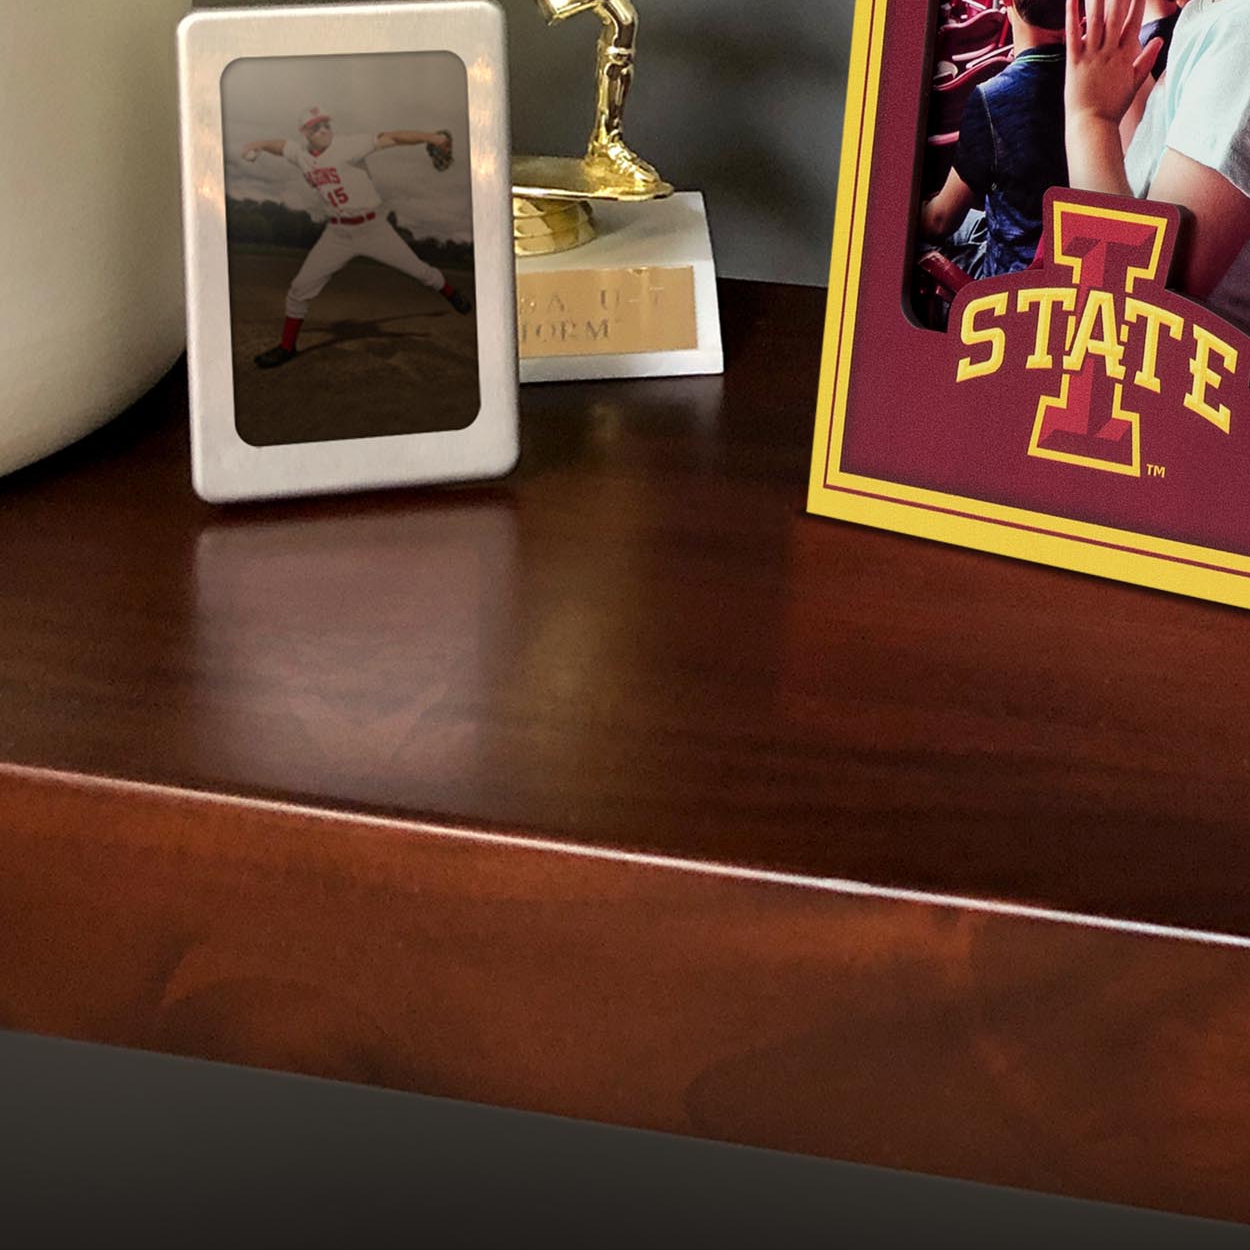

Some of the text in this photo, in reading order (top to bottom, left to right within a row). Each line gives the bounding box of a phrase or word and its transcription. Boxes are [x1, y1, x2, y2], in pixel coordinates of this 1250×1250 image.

[327, 186, 350, 208] 15
[955, 286, 1239, 435] STATE
[1146, 464, 1166, 478] TM
